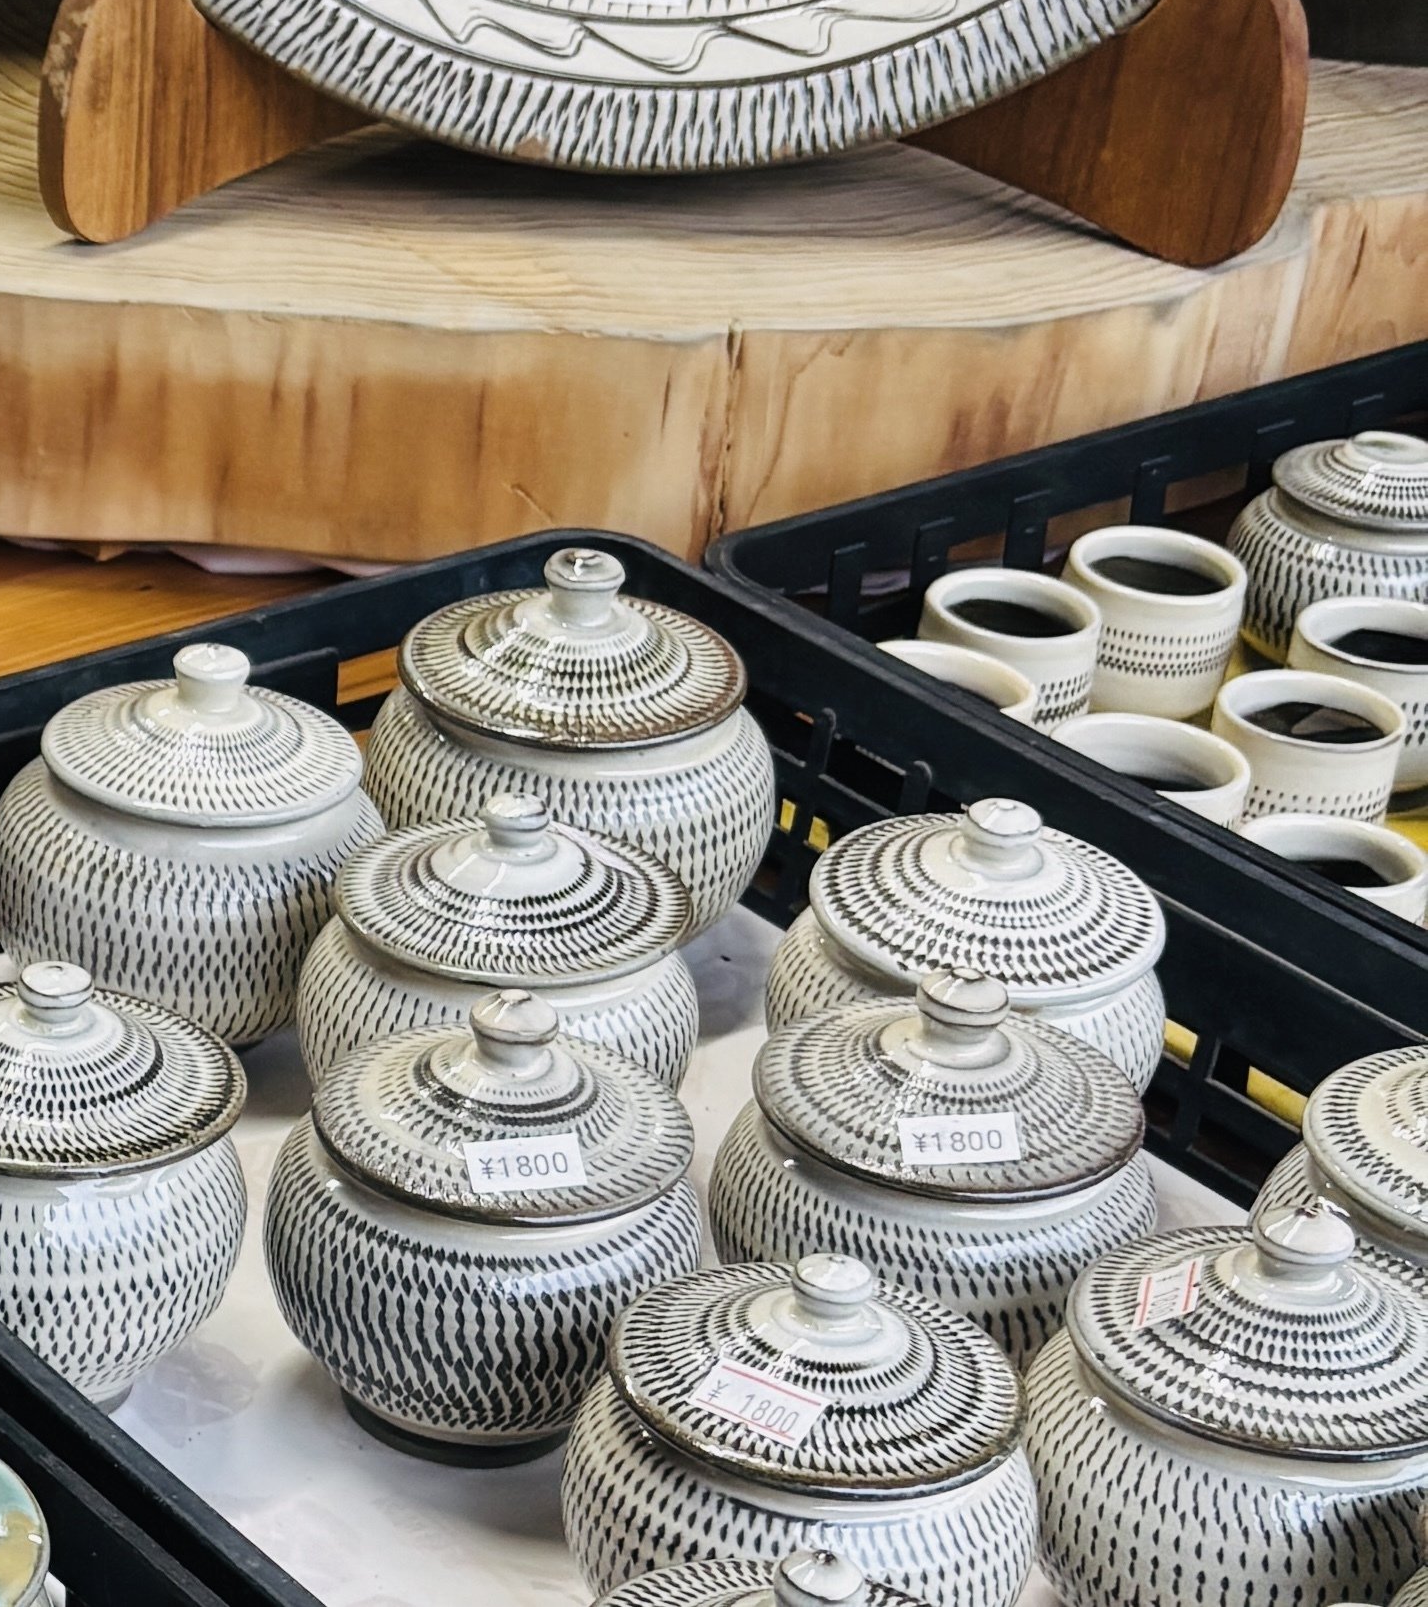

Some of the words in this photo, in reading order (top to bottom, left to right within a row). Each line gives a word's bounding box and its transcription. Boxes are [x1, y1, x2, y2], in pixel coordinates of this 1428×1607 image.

[912, 1128, 1003, 1153] ¥1800
[477, 1151, 570, 1180] ¥1800
[707, 1379, 800, 1435] ¥1800
